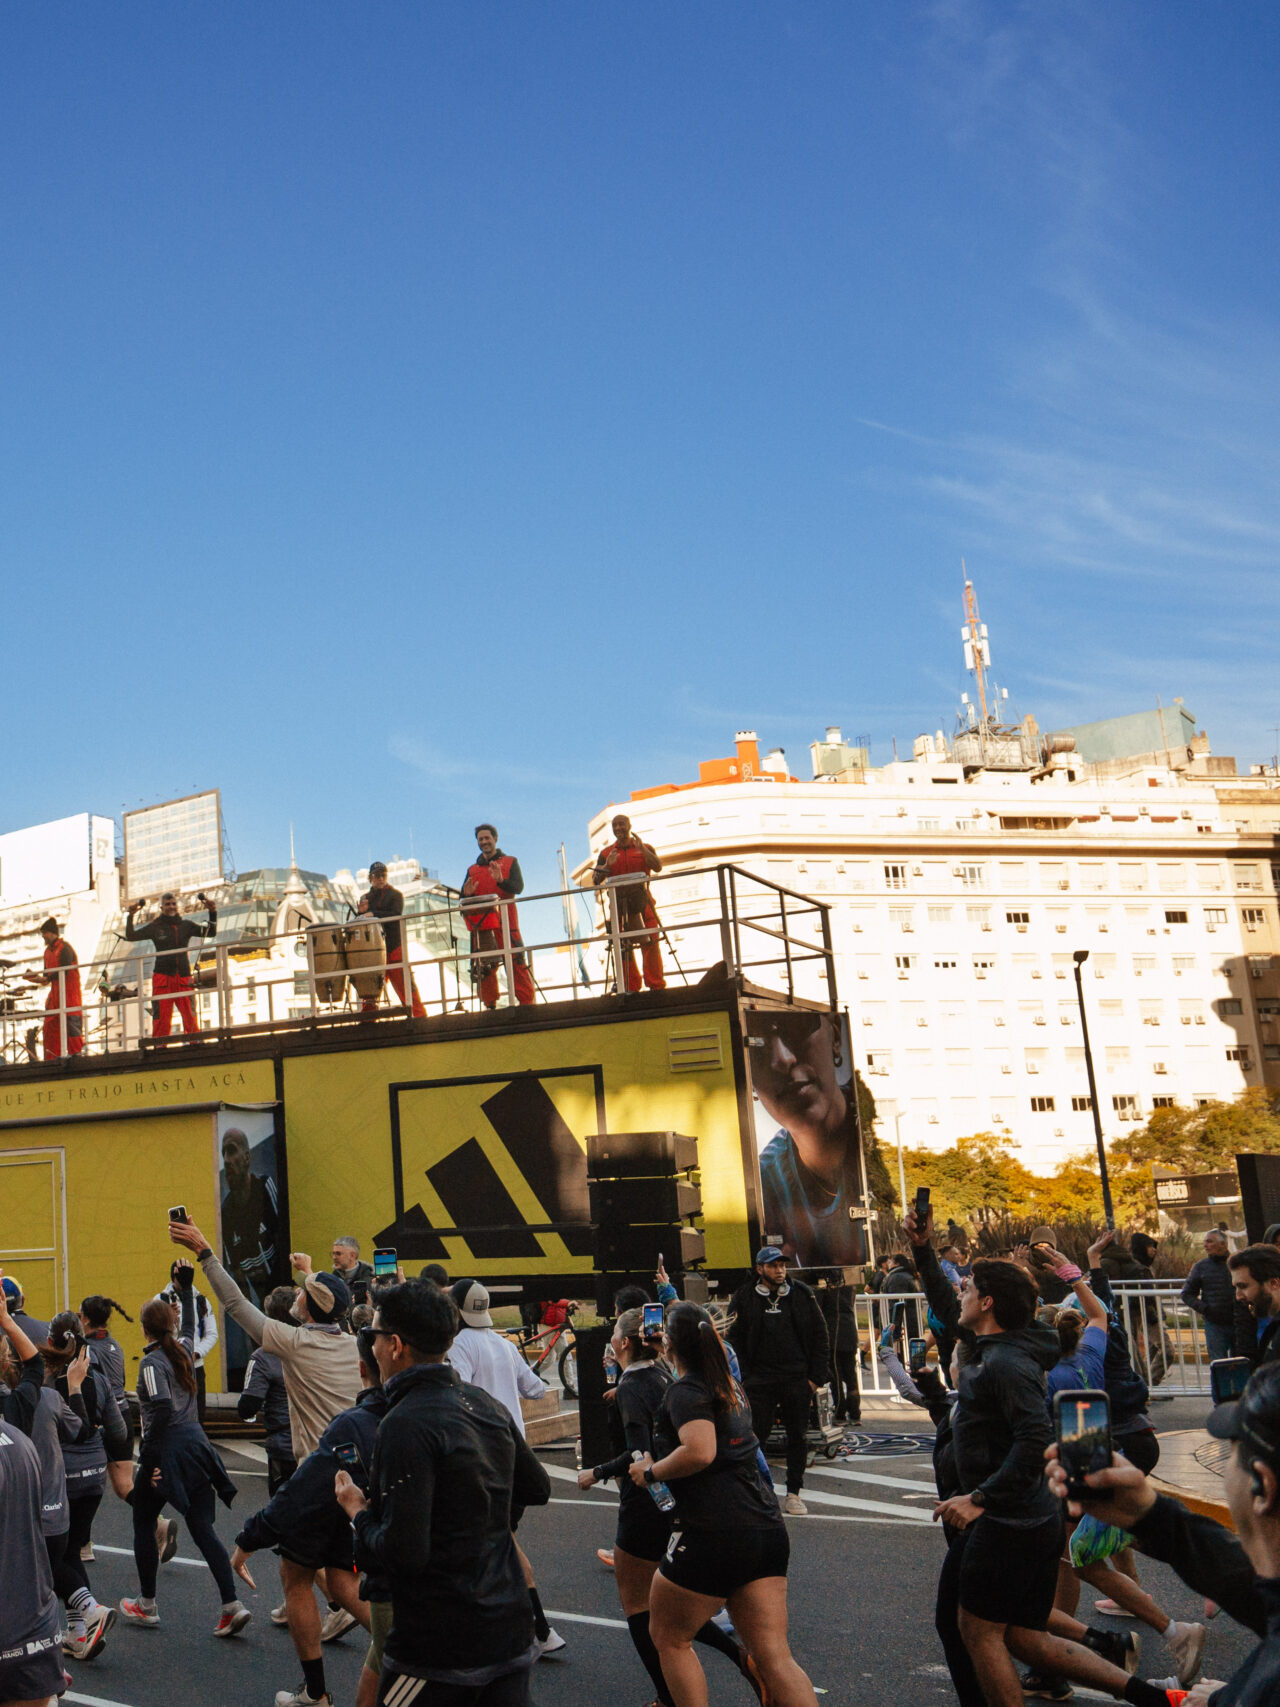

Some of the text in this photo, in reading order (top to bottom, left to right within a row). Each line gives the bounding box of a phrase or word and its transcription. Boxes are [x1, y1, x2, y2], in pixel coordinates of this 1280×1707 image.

[37, 1091, 56, 1103] TE
[67, 1084, 122, 1100] TRAJO
[135, 1078, 195, 1094] HASTA
